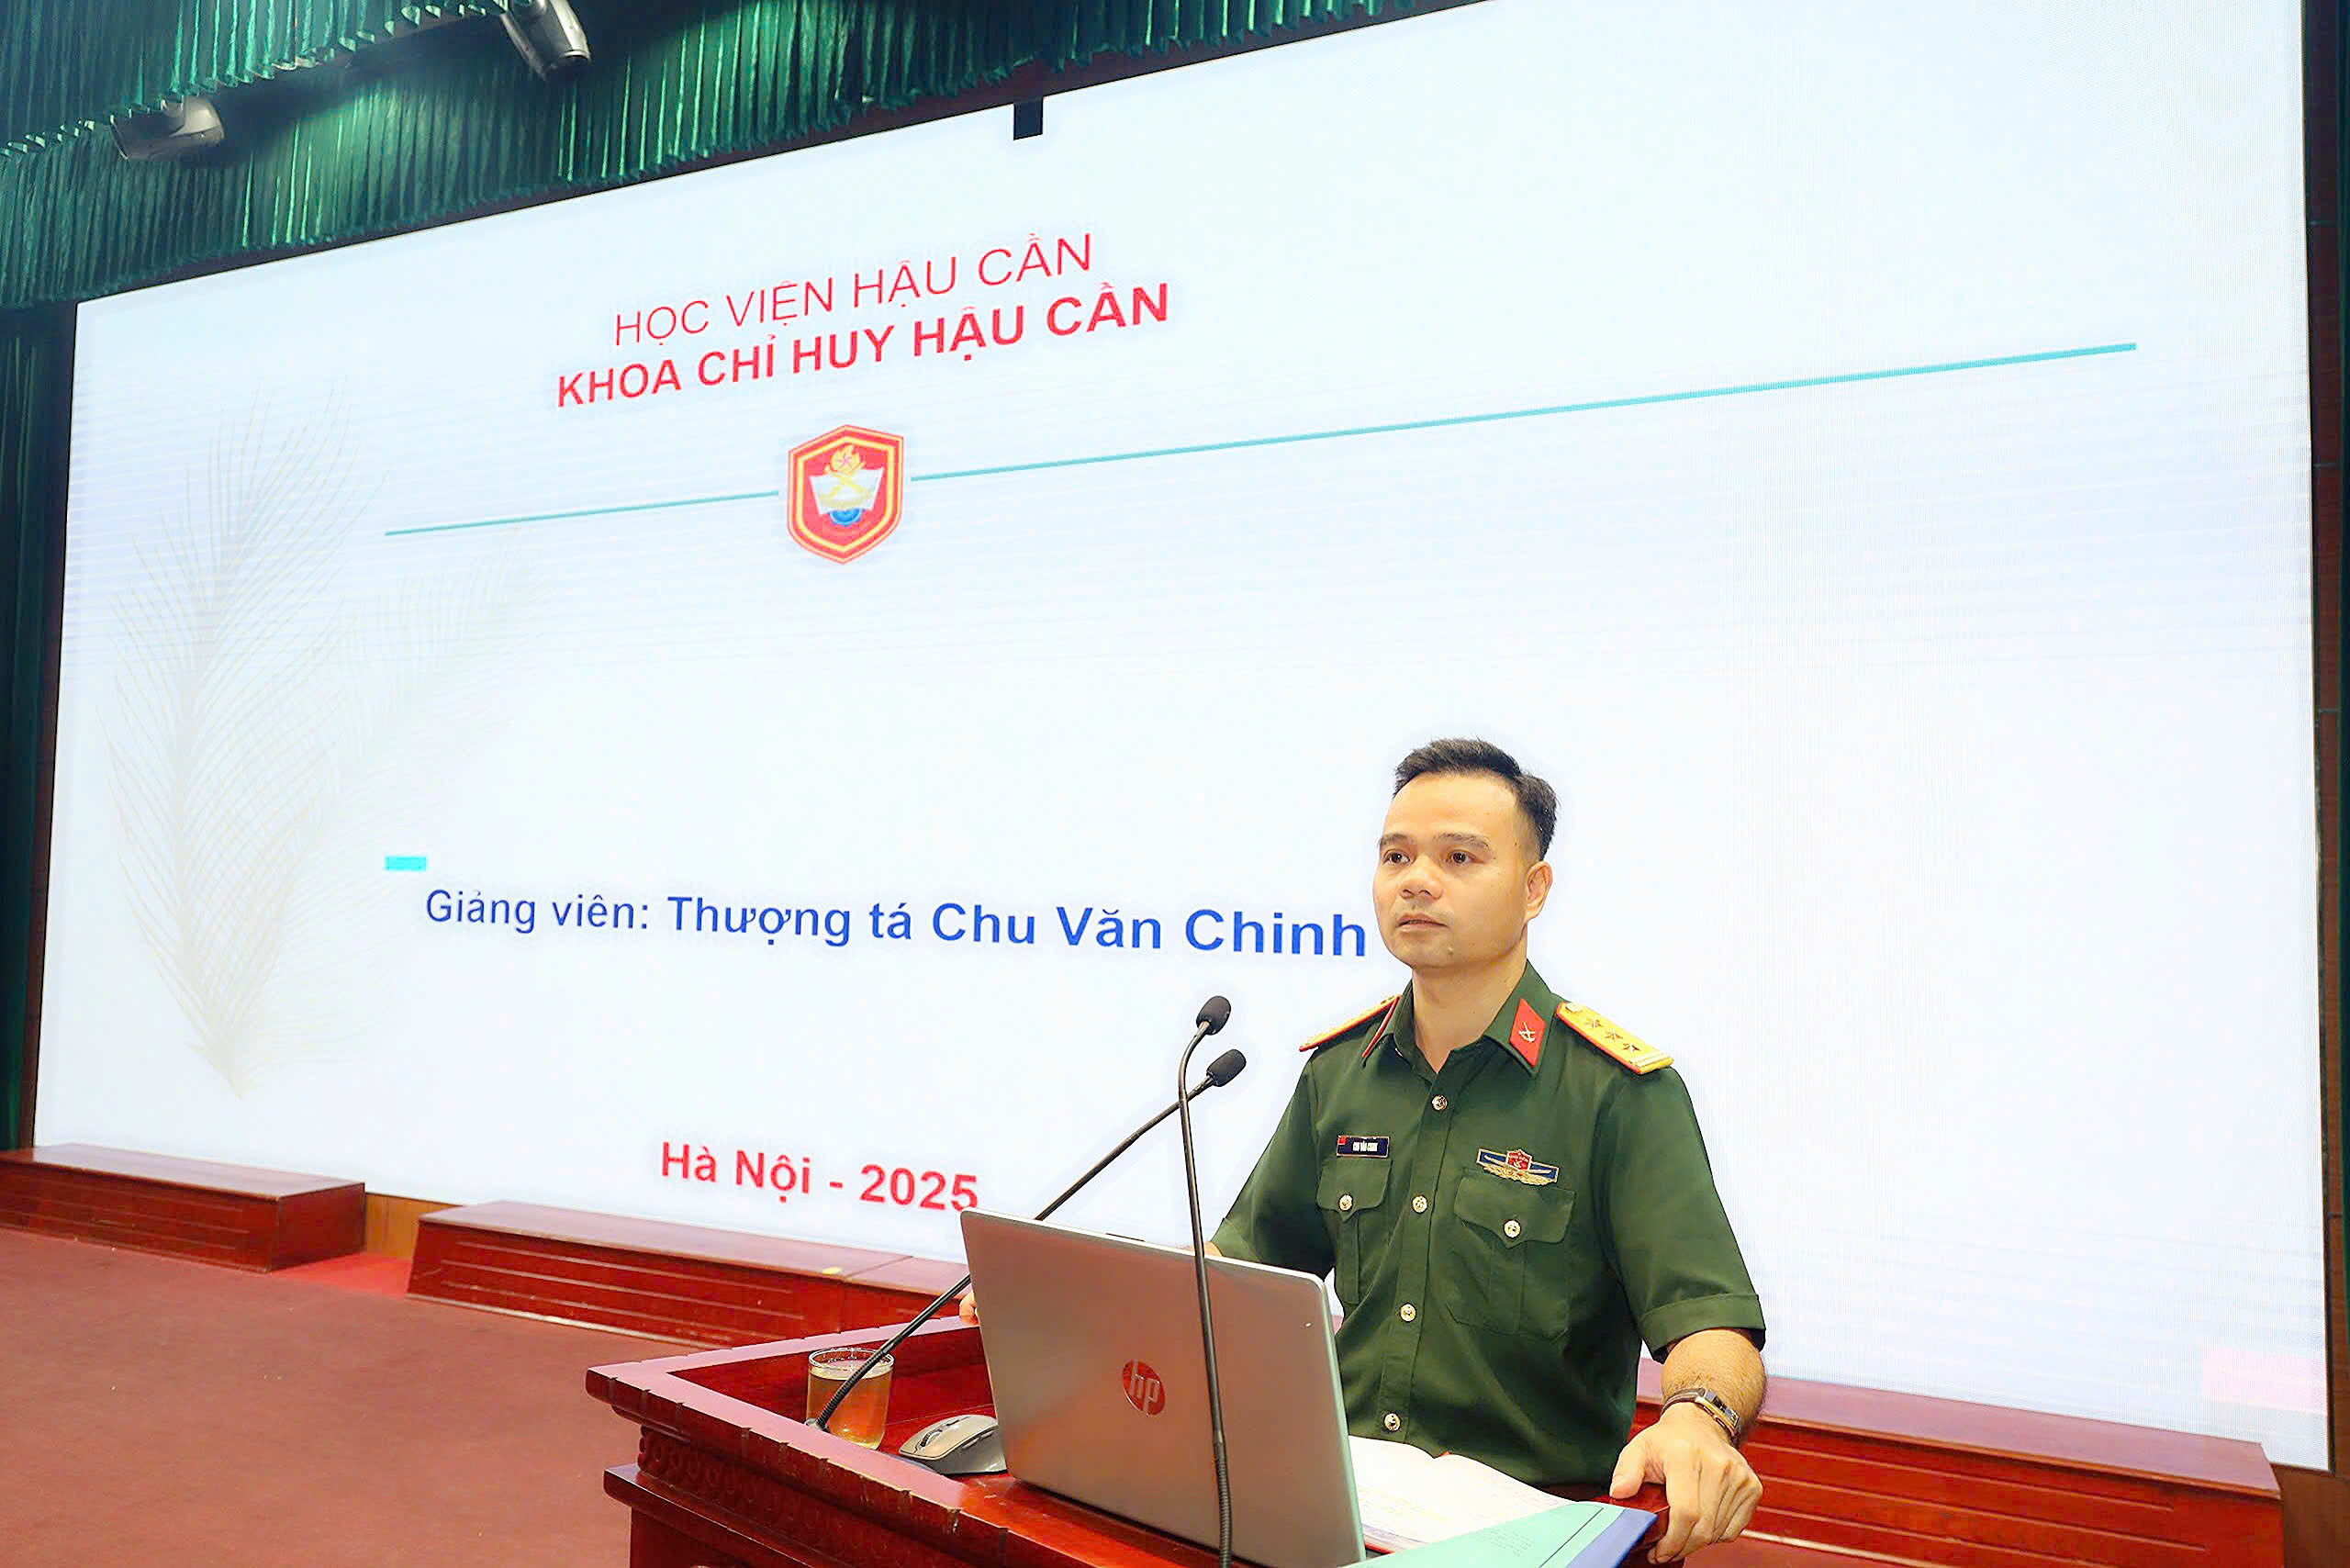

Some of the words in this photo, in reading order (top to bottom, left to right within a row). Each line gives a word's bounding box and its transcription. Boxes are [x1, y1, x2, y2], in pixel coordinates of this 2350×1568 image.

[616, 300, 710, 346] HỌC
[726, 276, 834, 328] VIỆN
[853, 256, 957, 308] HẬU
[978, 232, 1091, 286] CẦN
[557, 359, 682, 408] KHOA
[697, 334, 777, 386] CHỈ
[792, 324, 896, 375] HUY
[913, 305, 1024, 362] HẬU
[1046, 282, 1168, 337] CẦN
[426, 889, 535, 934] Giảng
[551, 893, 647, 930] viên:
[667, 896, 851, 948] Thượng
[868, 902, 912, 941] tá
[932, 902, 1035, 945] Chu
[1057, 906, 1161, 950] Văn
[1185, 908, 1366, 958] Chinh
[662, 1141, 717, 1183] Hà
[735, 1149, 811, 1204] Nội
[858, 1163, 979, 1211] 2025
[1130, 1359, 1160, 1416] hp
